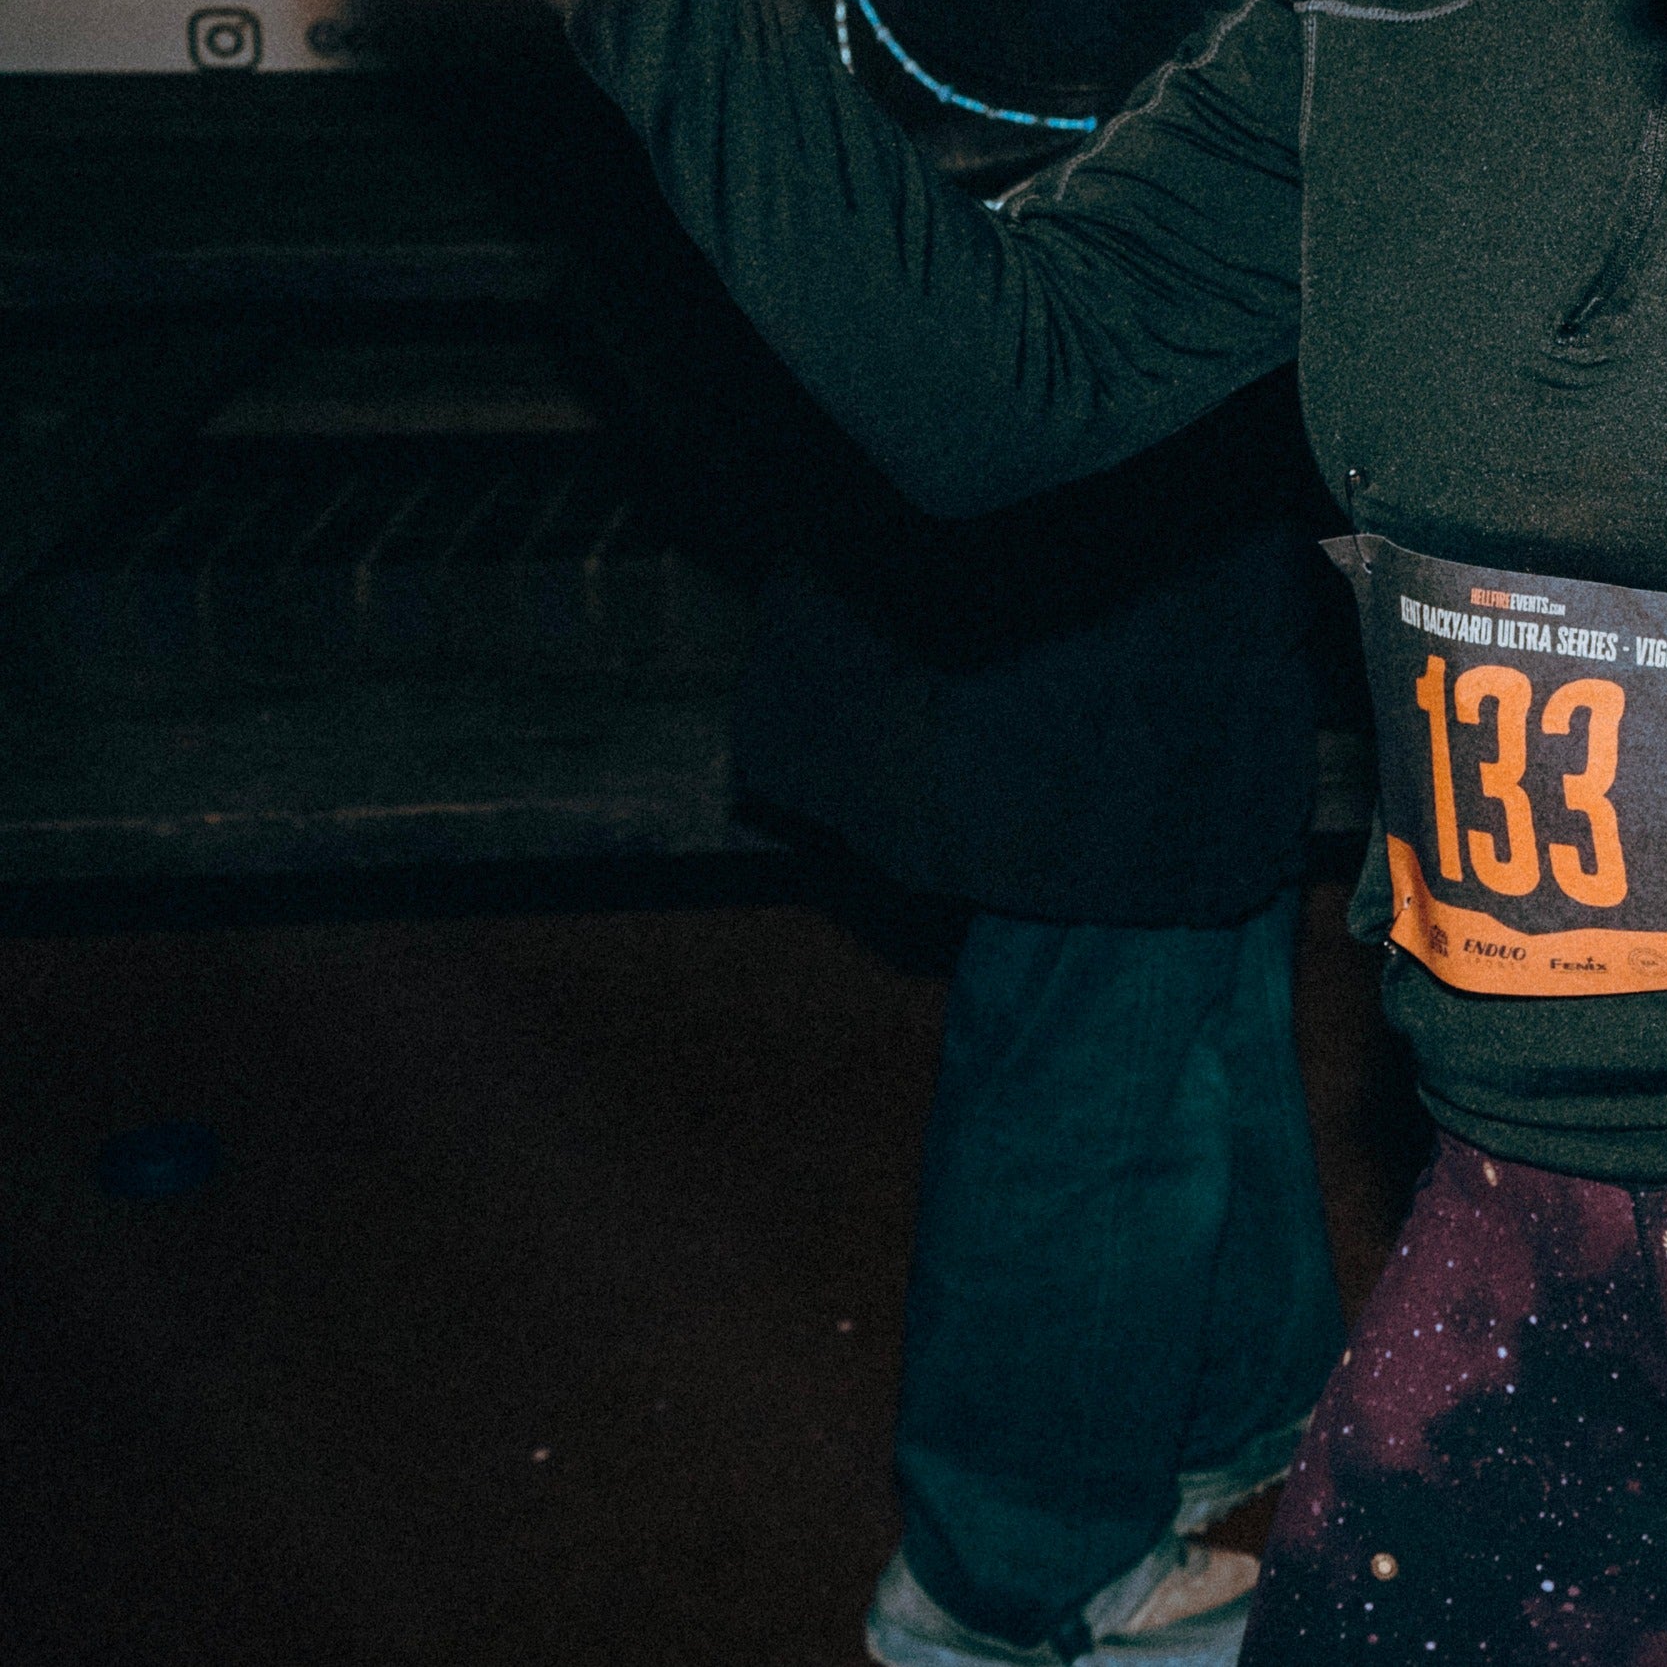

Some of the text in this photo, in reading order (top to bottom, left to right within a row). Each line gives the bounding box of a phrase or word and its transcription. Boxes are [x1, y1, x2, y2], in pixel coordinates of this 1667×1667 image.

[1423, 604, 1492, 646] BACKYARD
[1497, 619, 1552, 653] ULTRA
[1556, 626, 1618, 663] SERIES
[1415, 654, 1628, 908] 133
[1463, 939, 1526, 961] ENDUO
